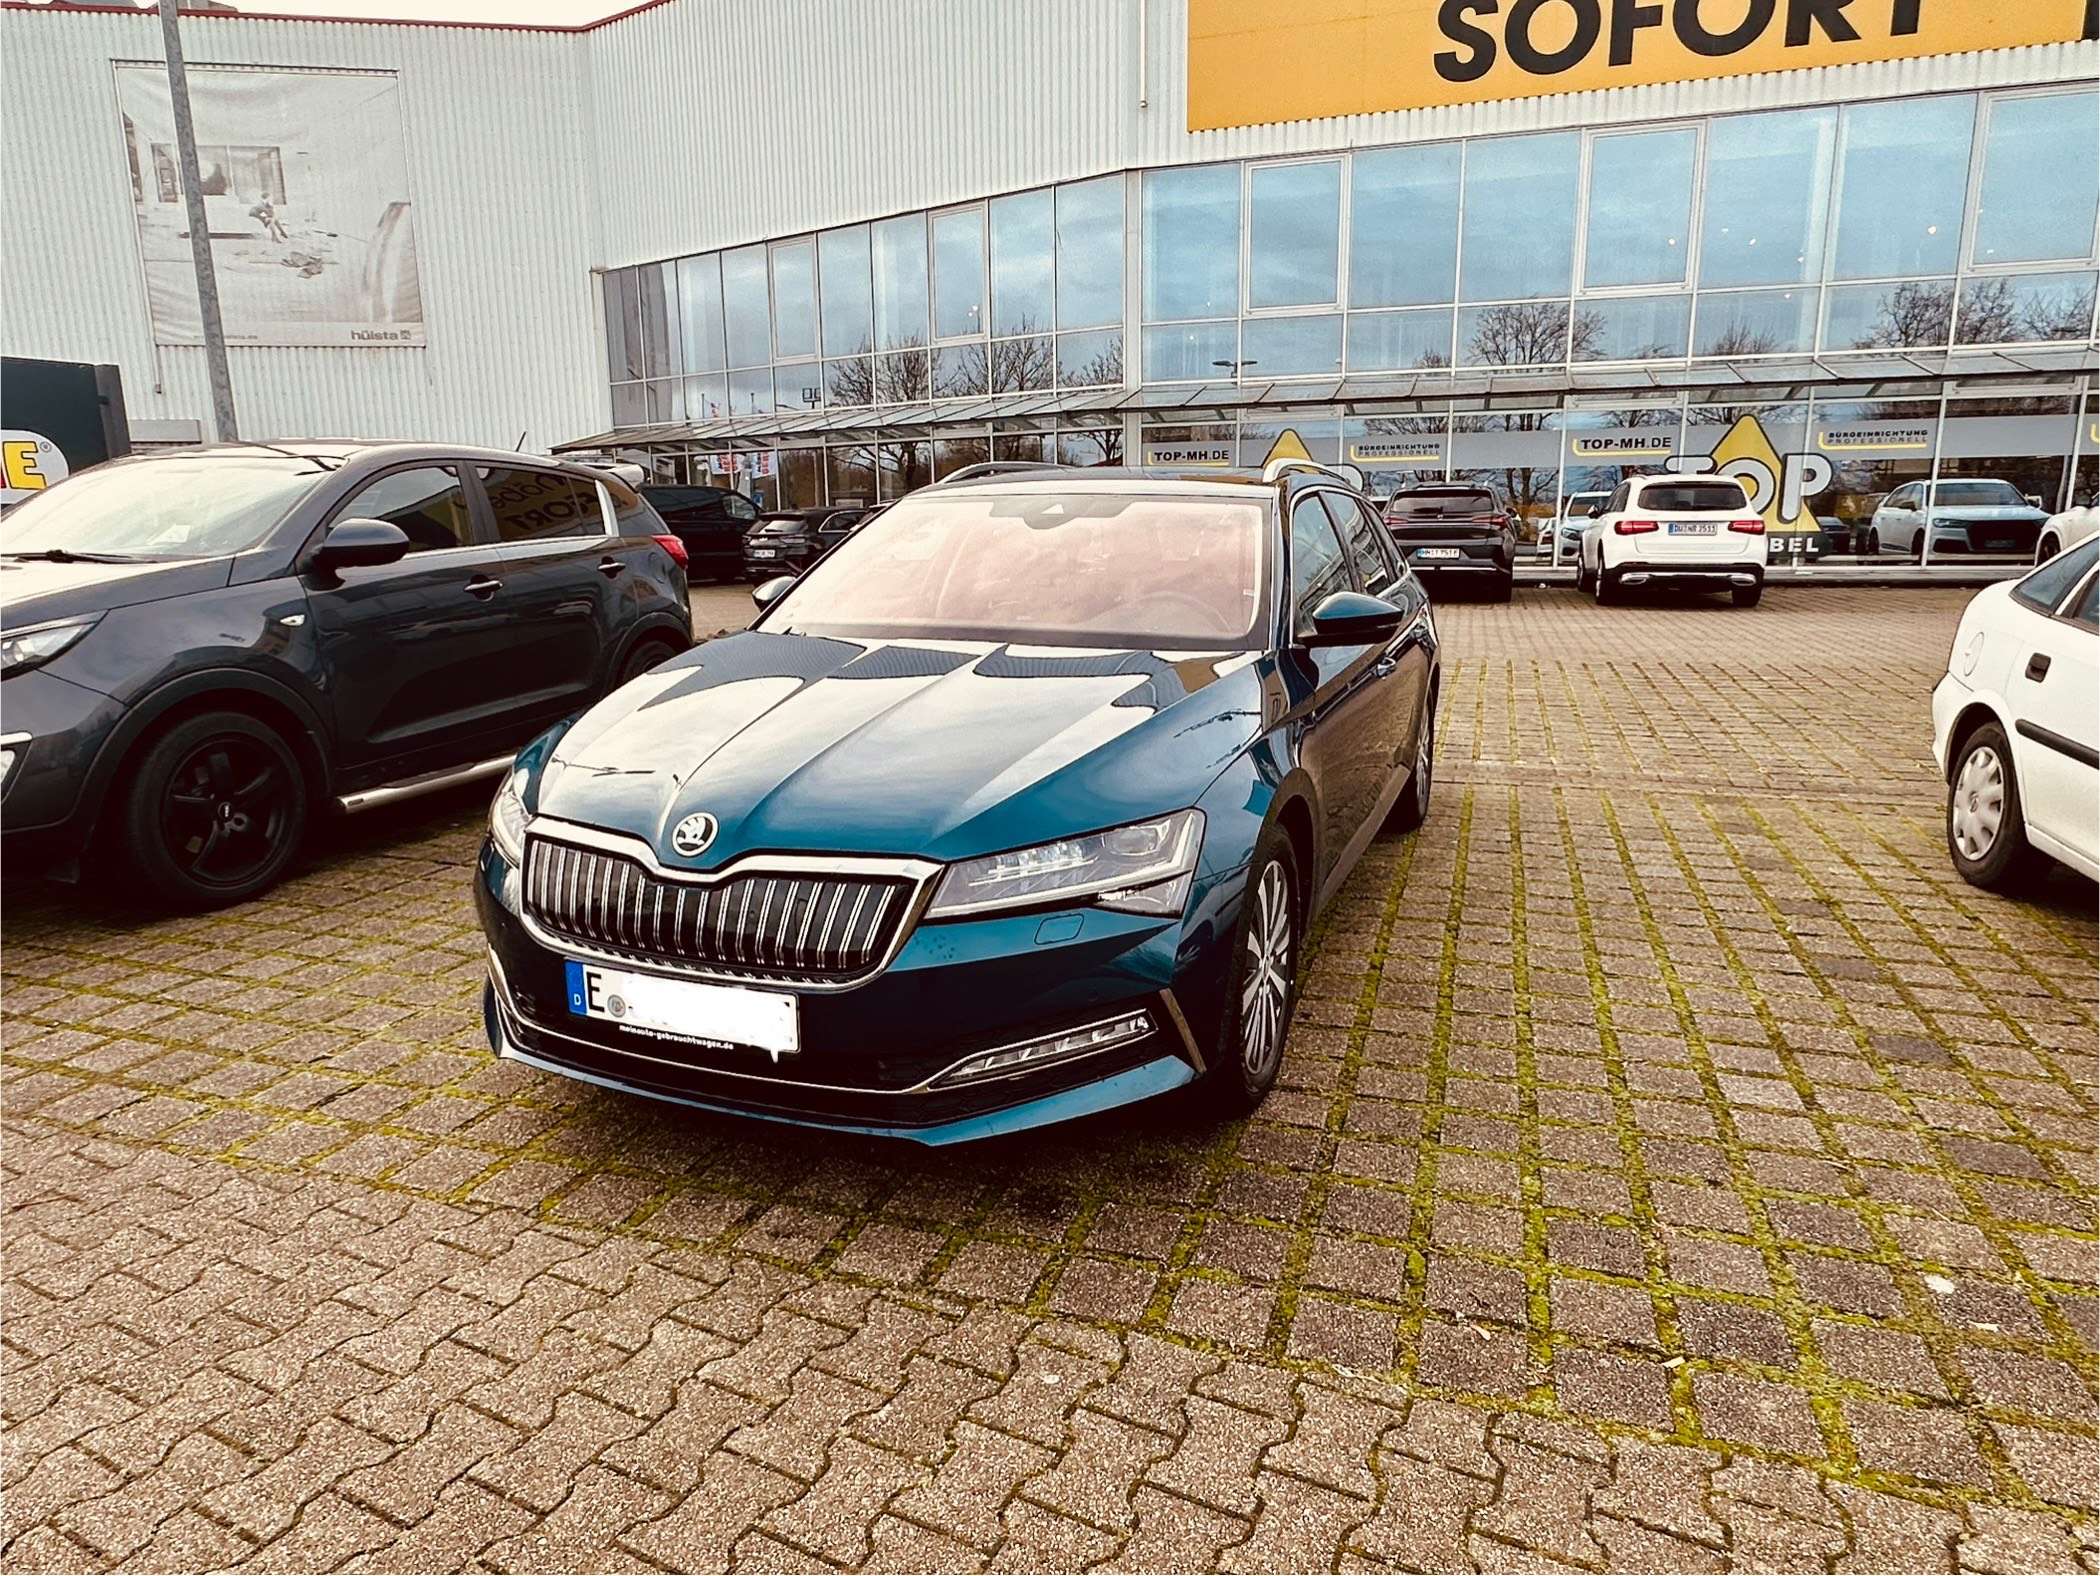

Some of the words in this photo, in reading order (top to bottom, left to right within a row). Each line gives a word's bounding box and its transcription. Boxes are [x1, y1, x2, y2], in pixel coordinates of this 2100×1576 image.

[351, 330, 399, 340] hülsta
[1828, 429, 1928, 438] BÜROEINRICHTUNG
[1580, 436, 1672, 450] TOP-MH.DE
[1827, 436, 1927, 444] PROFESSIONELL
[1358, 443, 1440, 451] BÜROEINRICHTUNG
[1154, 450, 1230, 461] TOP-MH.DE
[1, 441, 47, 490] E
[586, 971, 605, 1012] E
[573, 994, 582, 1006] D
